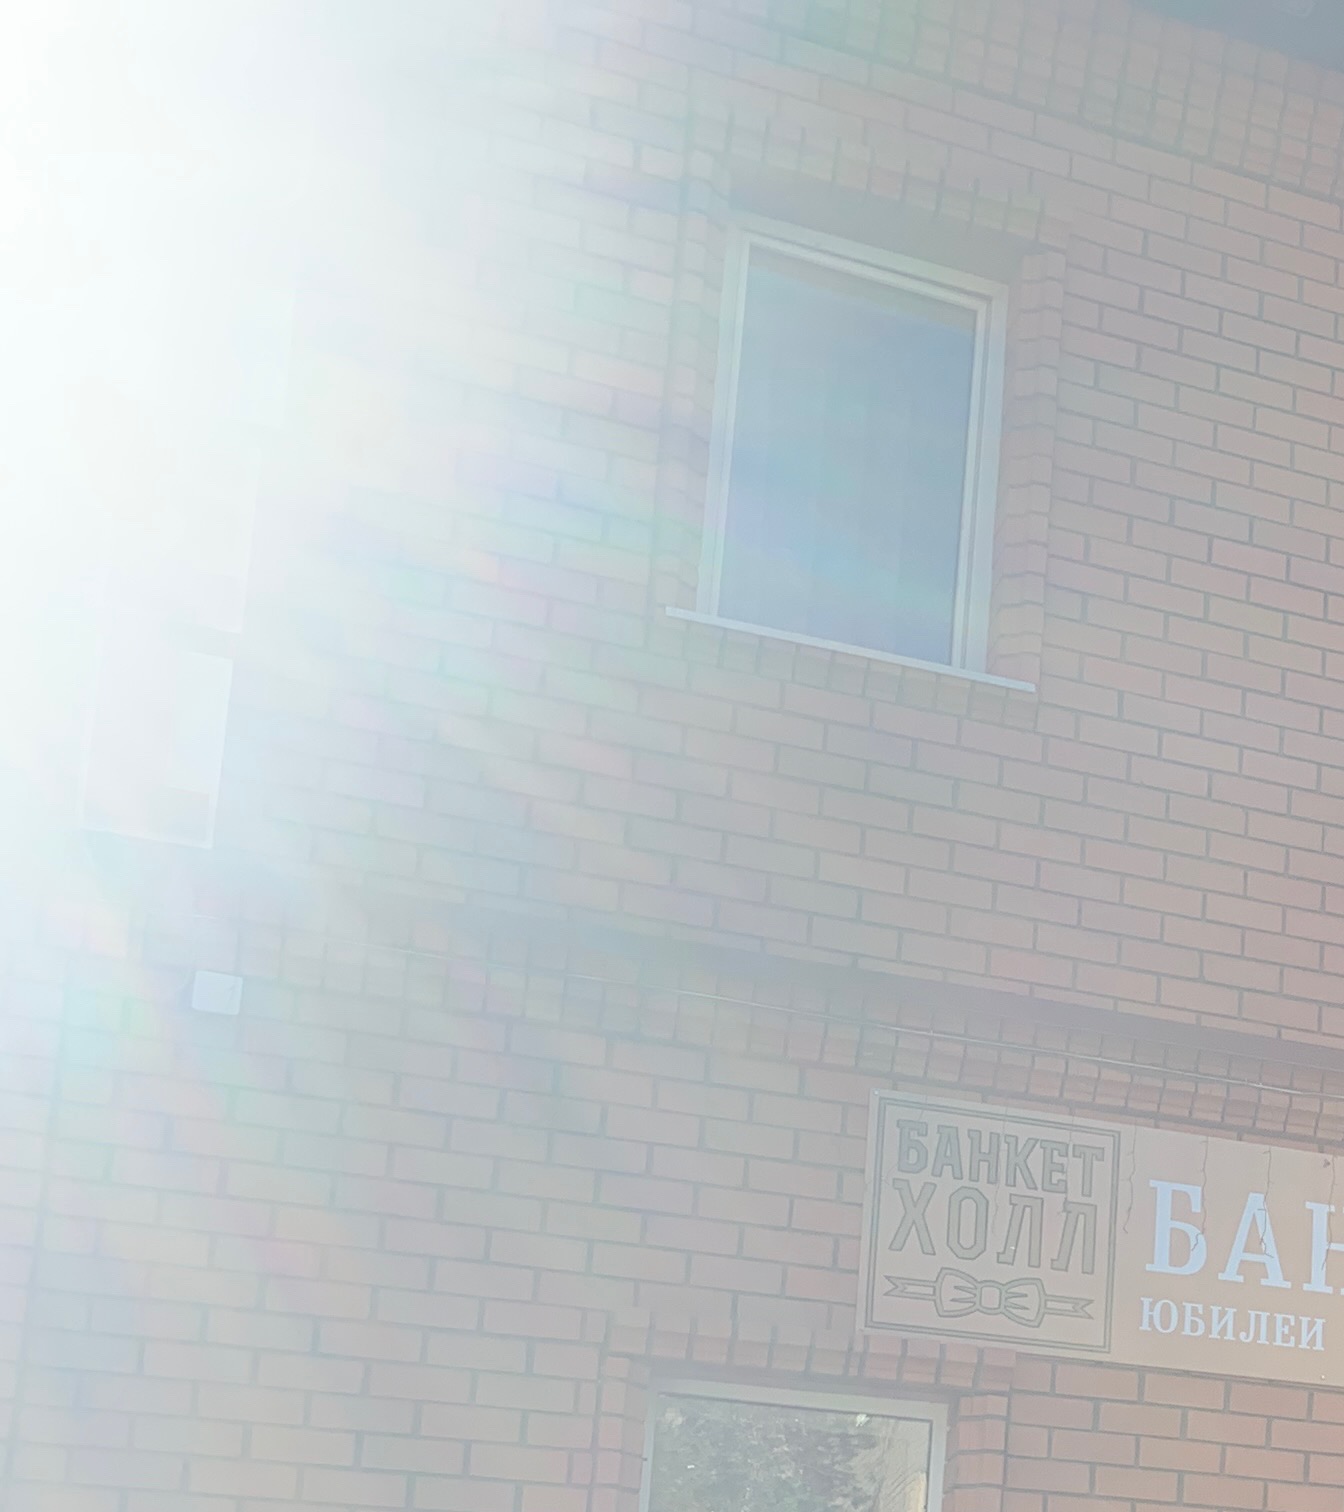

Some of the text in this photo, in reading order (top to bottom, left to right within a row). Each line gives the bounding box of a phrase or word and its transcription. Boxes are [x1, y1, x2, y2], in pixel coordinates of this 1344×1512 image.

[895, 1118, 1105, 1197] БАНКЕТ
[888, 1179, 1098, 1275] ХОЛЛ
[1139, 1297, 1326, 1352] ЮБИЛЕИ
